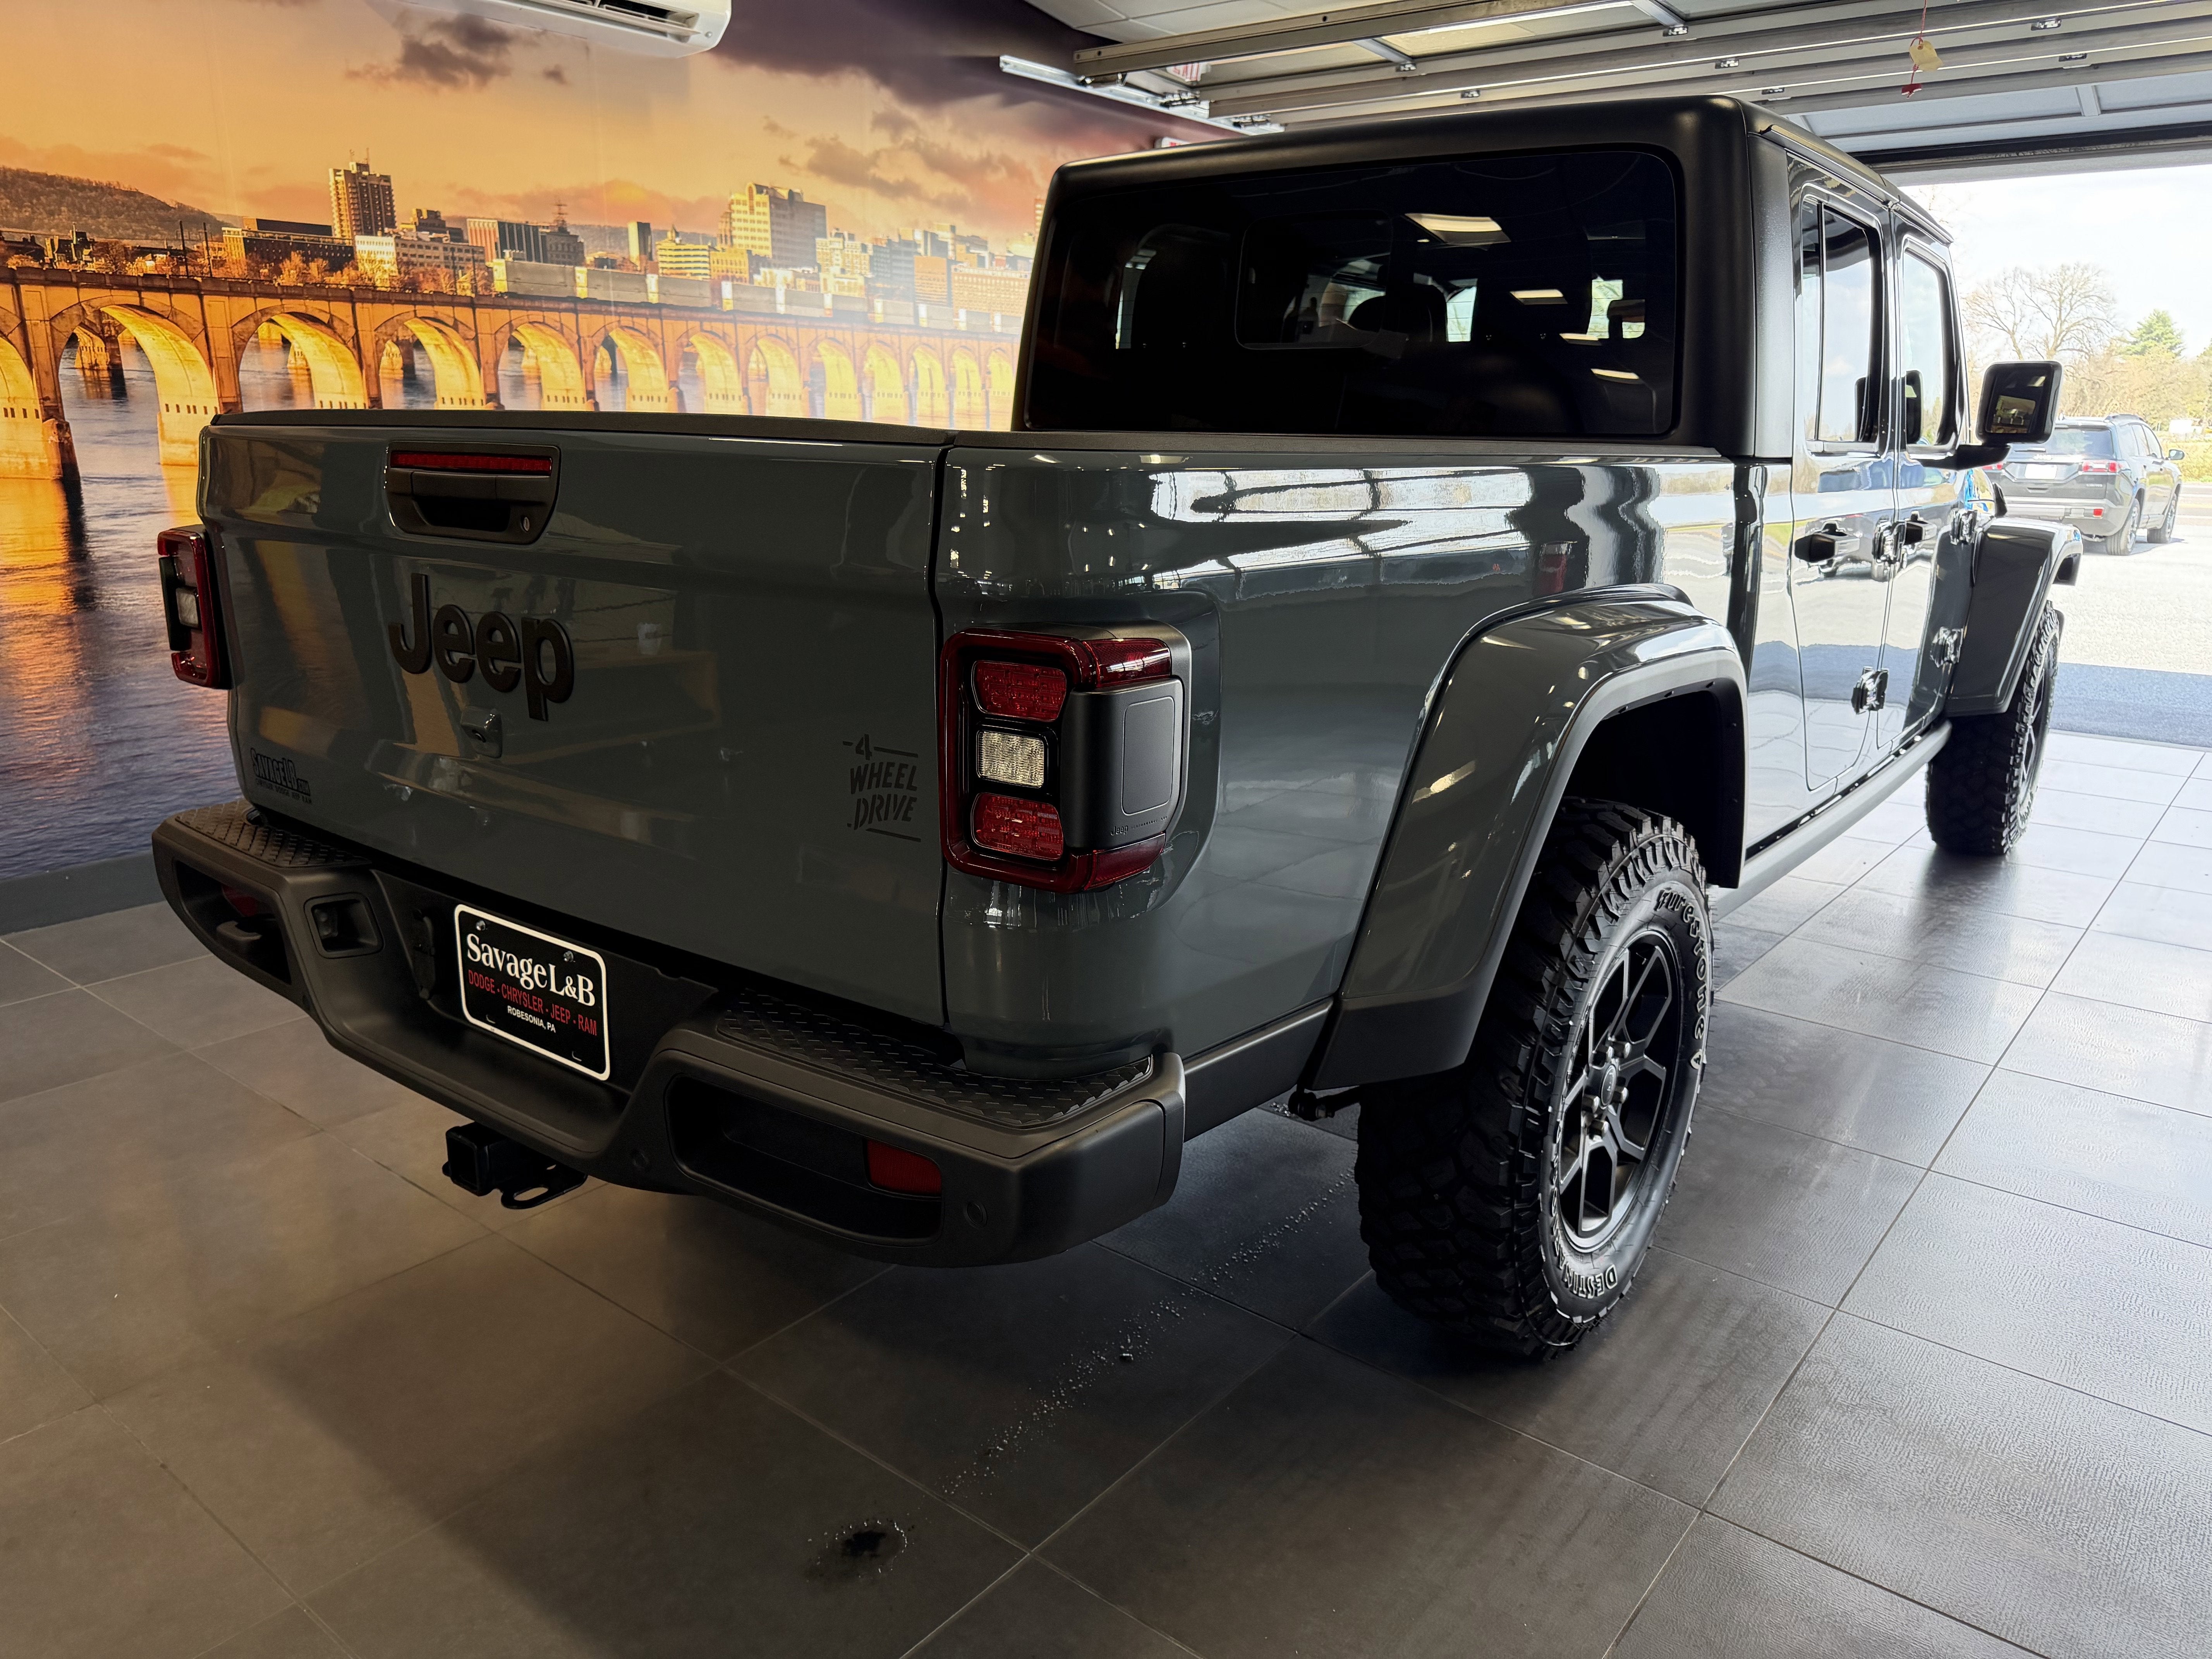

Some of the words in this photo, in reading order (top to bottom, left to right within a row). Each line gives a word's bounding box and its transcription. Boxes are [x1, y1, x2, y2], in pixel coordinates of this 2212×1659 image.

[388, 573, 574, 721] Jeep
[855, 733, 872, 760] 4
[850, 761, 917, 794] WHEEL
[854, 793, 917, 830] DRIVE
[1111, 825, 1128, 836] Jeep
[468, 969, 495, 994] DODGE
[501, 983, 544, 1014] CHRYSLER
[550, 1003, 570, 1024] JEEP
[578, 1015, 597, 1036] RAM
[507, 1005, 546, 1030] ROBESONIA,
[547, 1022, 556, 1033] PA
